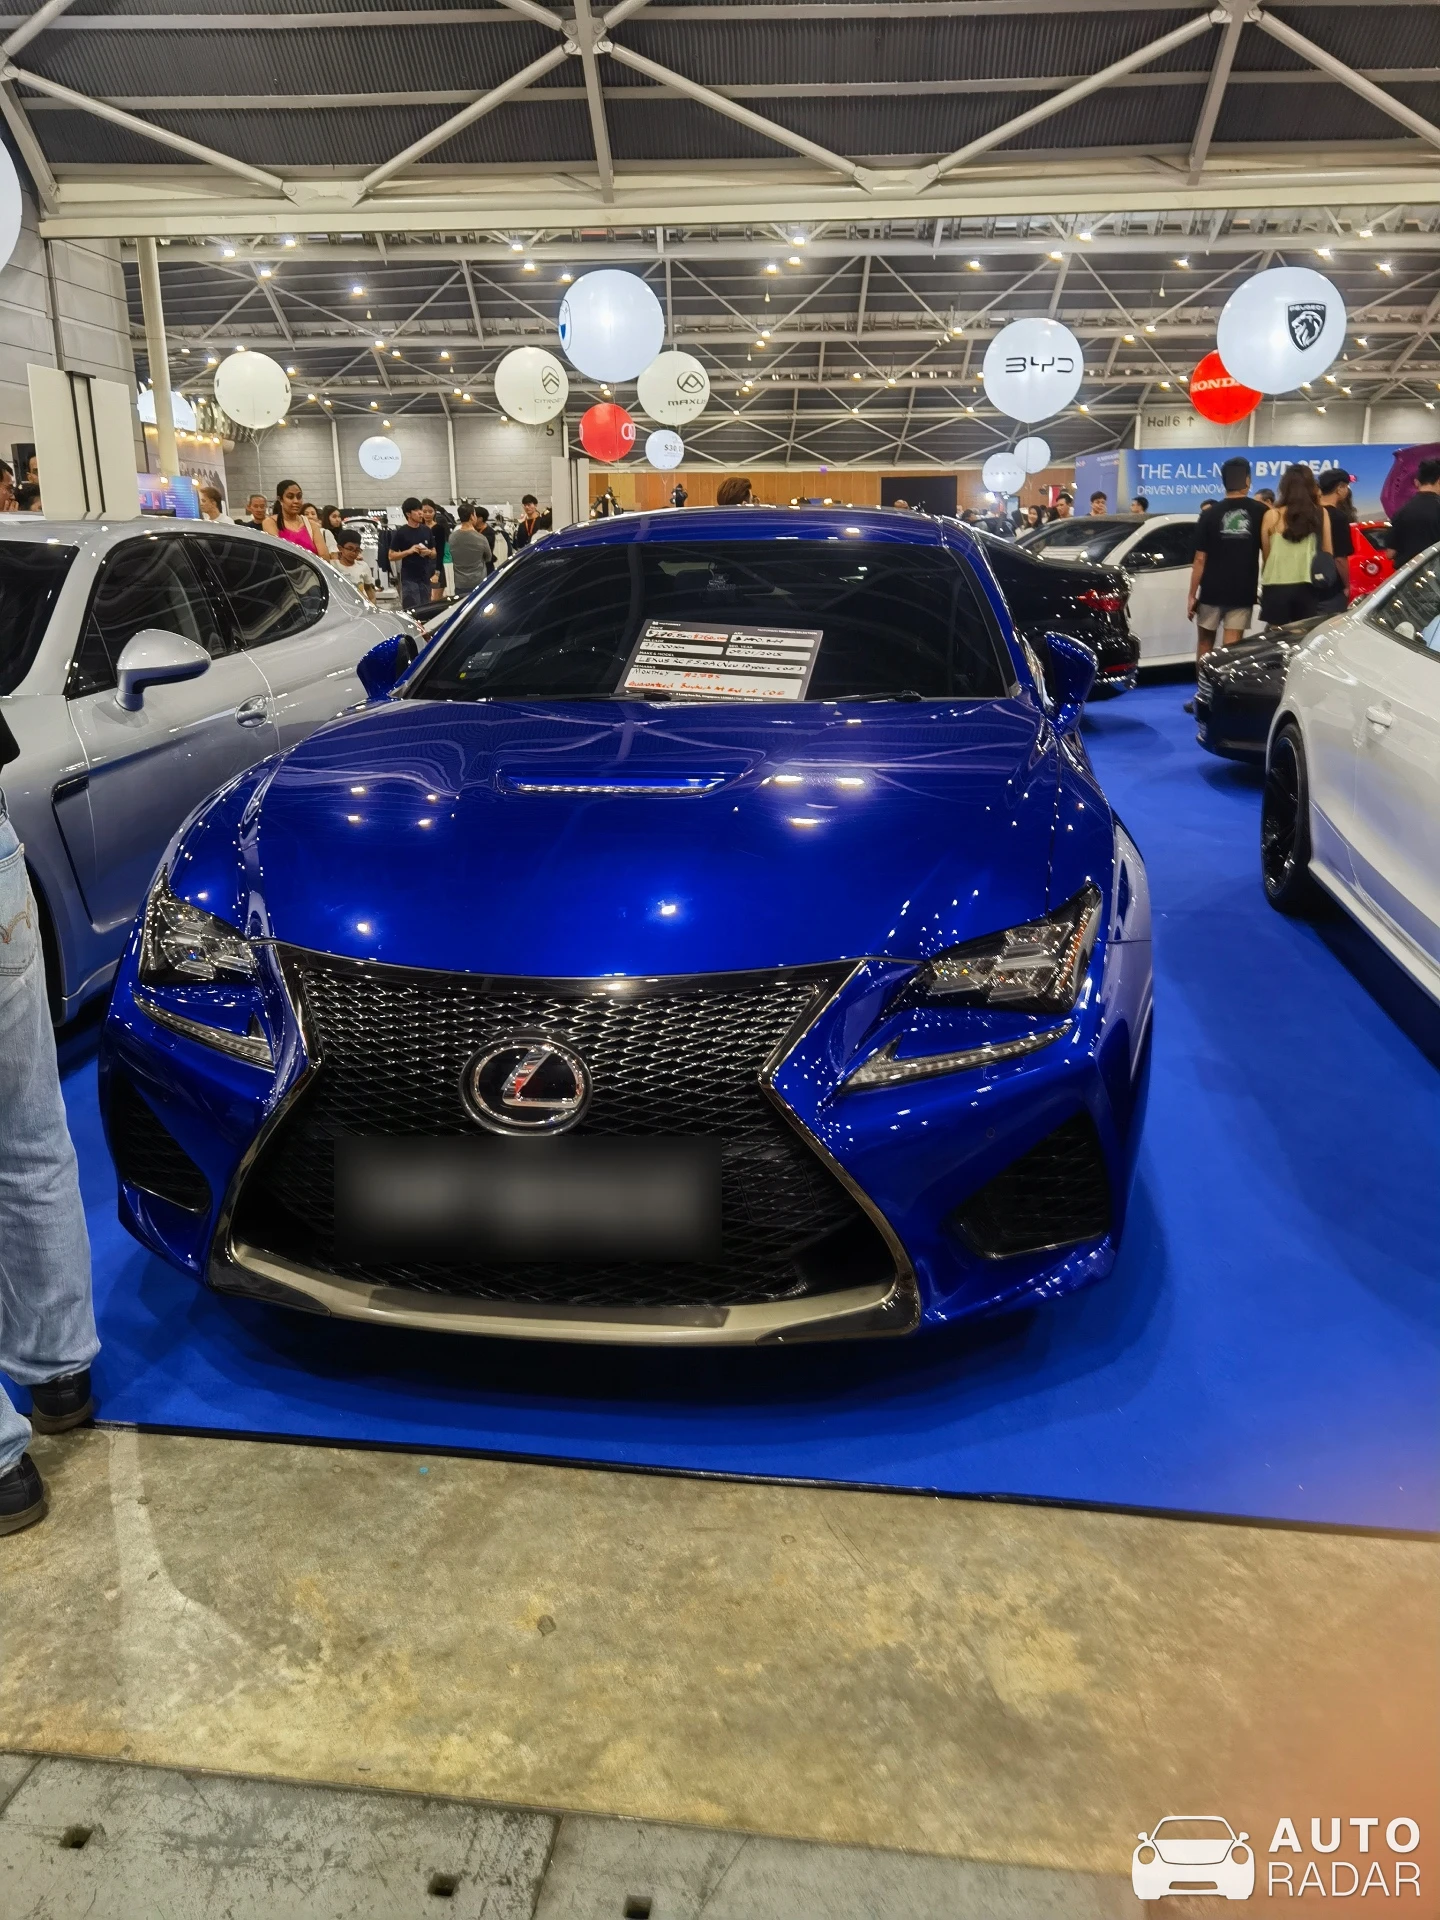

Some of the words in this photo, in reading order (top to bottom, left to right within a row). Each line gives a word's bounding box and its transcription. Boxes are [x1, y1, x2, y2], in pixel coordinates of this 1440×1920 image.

[1005, 356, 1075, 374] BYD
[1190, 377, 1241, 392] HOND
[1147, 415, 1170, 427] Hall
[1172, 415, 1181, 427] 6
[545, 425, 555, 437] 5
[1138, 463, 1172, 480] THE
[1137, 485, 1173, 496] DRIVEN
[1176, 484, 1189, 495] BY
